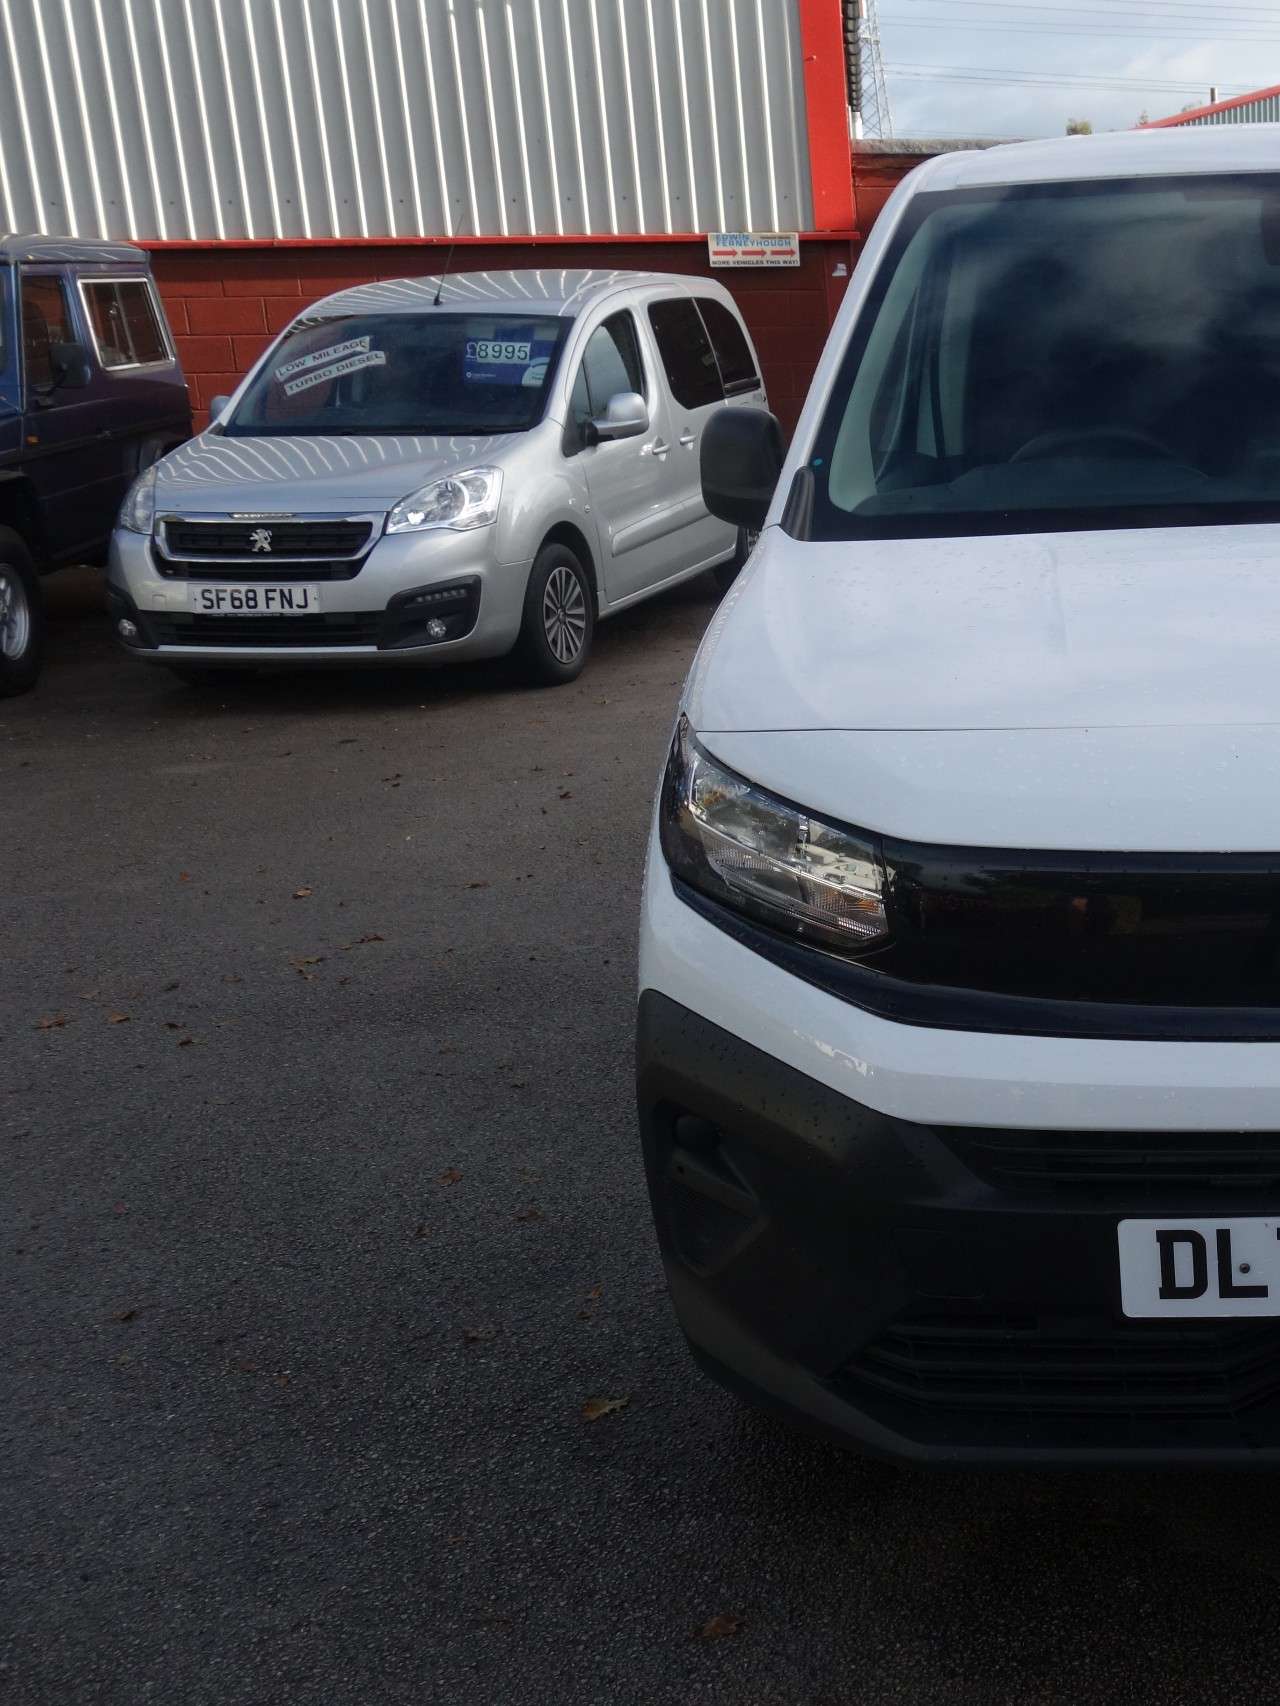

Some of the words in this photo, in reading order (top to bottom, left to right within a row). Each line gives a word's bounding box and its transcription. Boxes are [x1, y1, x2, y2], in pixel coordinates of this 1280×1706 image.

[279, 358, 305, 377] LOW
[312, 339, 367, 362] MILEAGE
[288, 369, 333, 392] TURBO
[336, 352, 384, 373] DIESEL
[201, 588, 258, 610] SF68
[264, 588, 309, 609] FNJ
